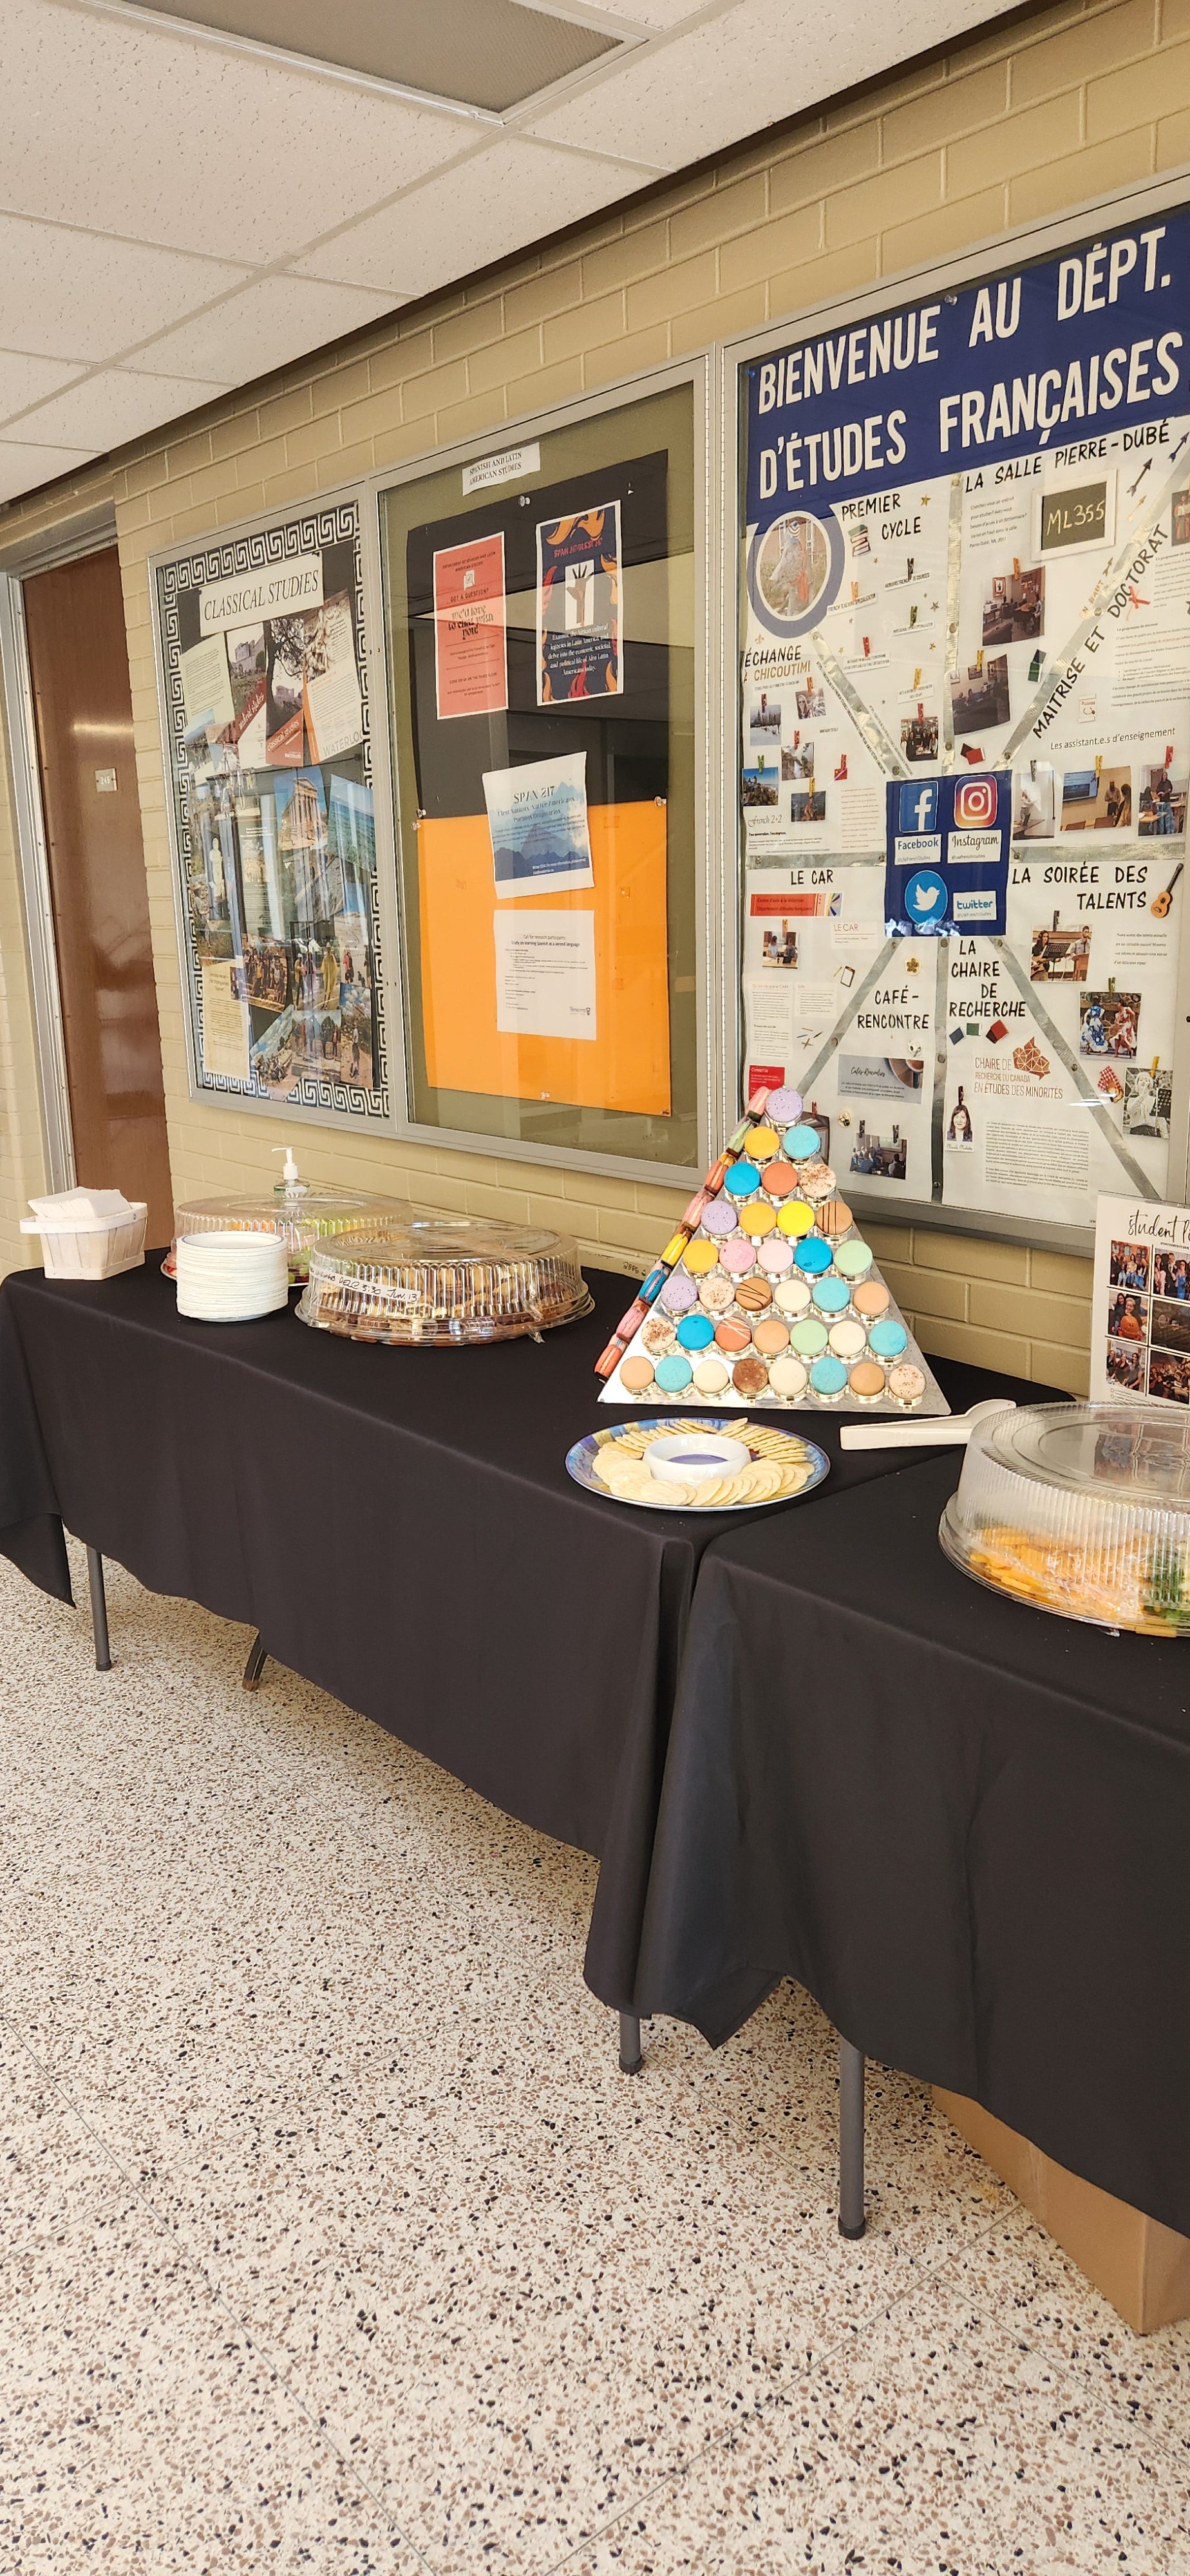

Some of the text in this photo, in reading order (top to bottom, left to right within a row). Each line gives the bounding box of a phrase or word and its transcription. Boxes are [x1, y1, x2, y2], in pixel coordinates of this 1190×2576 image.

[759, 227, 1171, 415] BIENVENUE AU DÉPT.
[759, 331, 1183, 499] D'ÉTUDES FRANÇAISES
[469, 451, 522, 476] SPANISH AND LATIN
[469, 462, 522, 486] AMERICAN STUDIES
[965, 472, 983, 493] LA
[995, 456, 1043, 484] SALLE
[842, 493, 901, 521] PREMIER
[882, 516, 921, 540] CYCLE
[204, 569, 319, 621] CLASSICAL STUDIES
[1084, 626, 1104, 654] ET
[744, 645, 802, 668] ÉCHANGE
[754, 660, 811, 681] CHICOUTIMI
[1032, 657, 1086, 739] MAITRISE
[1050, 727, 1175, 750] Les assistant.e.s d'enseignement
[898, 834, 999, 851] Facebook Instagram
[791, 869, 833, 886] LE CAR
[1012, 861, 1148, 884] LA SOIRÉE DES
[956, 899, 993, 910] twitter
[1077, 891, 1147, 910] TALENTS
[959, 940, 977, 955] LA
[951, 960, 1001, 978] CHAIRE
[981, 983, 998, 999] DE
[949, 1000, 1027, 1018] RECHERCHE
[856, 1014, 929, 1030] RENCONTRE
[975, 1057, 1012, 1071] CHAIRE DE
[975, 1072, 1002, 1081] RECHERCHE
[1010, 1074, 1031, 1083] CANADA
[974, 1081, 1063, 1099] EN ÉTUDES DES MINORITÉS
[1128, 1209, 1185, 1244] student
[361, 1284, 381, 1295] 3:30
[409, 1293, 418, 1302] 13
